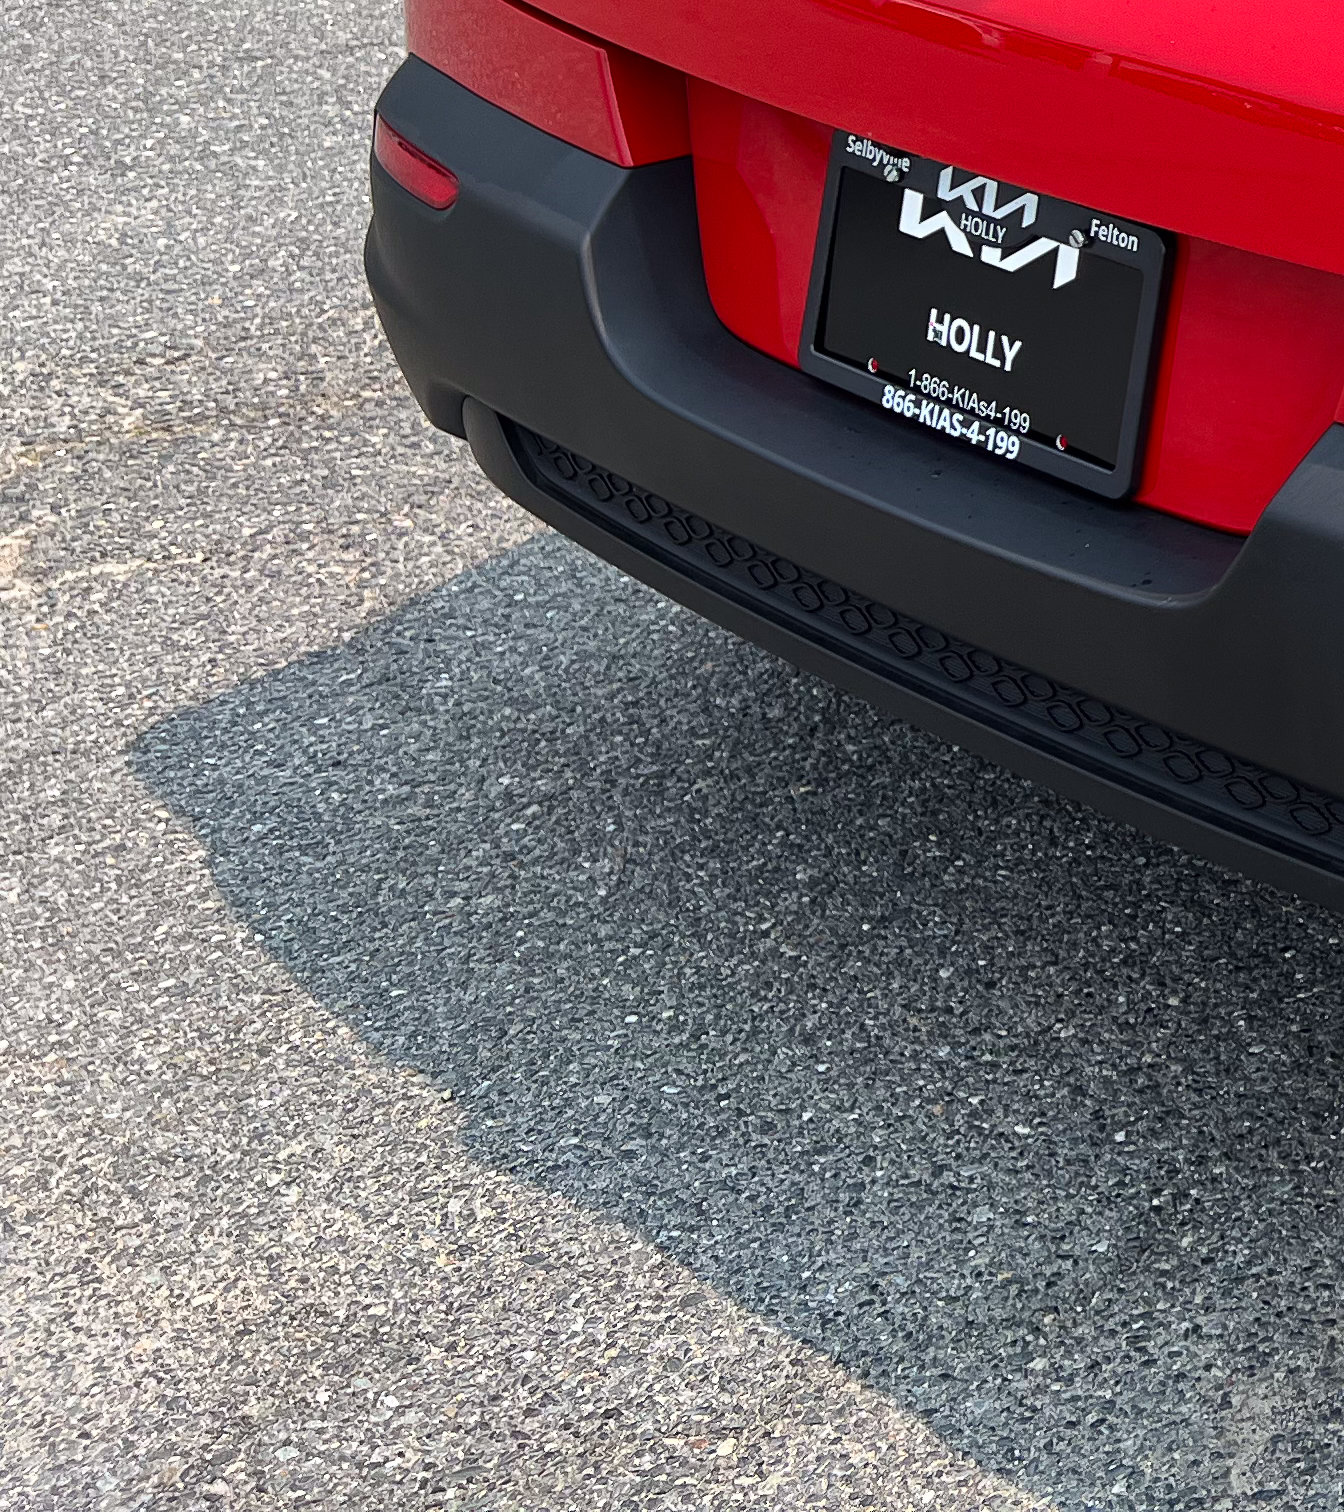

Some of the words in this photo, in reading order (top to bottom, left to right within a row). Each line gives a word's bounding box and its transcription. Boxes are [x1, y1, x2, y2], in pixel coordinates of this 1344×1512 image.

[937, 165, 1039, 228] KIA
[959, 212, 1007, 244] HOLLY
[1090, 218, 1139, 252] Felton
[926, 307, 1023, 373] HOLLY
[881, 384, 1020, 460] 866-KIAS-4-199
